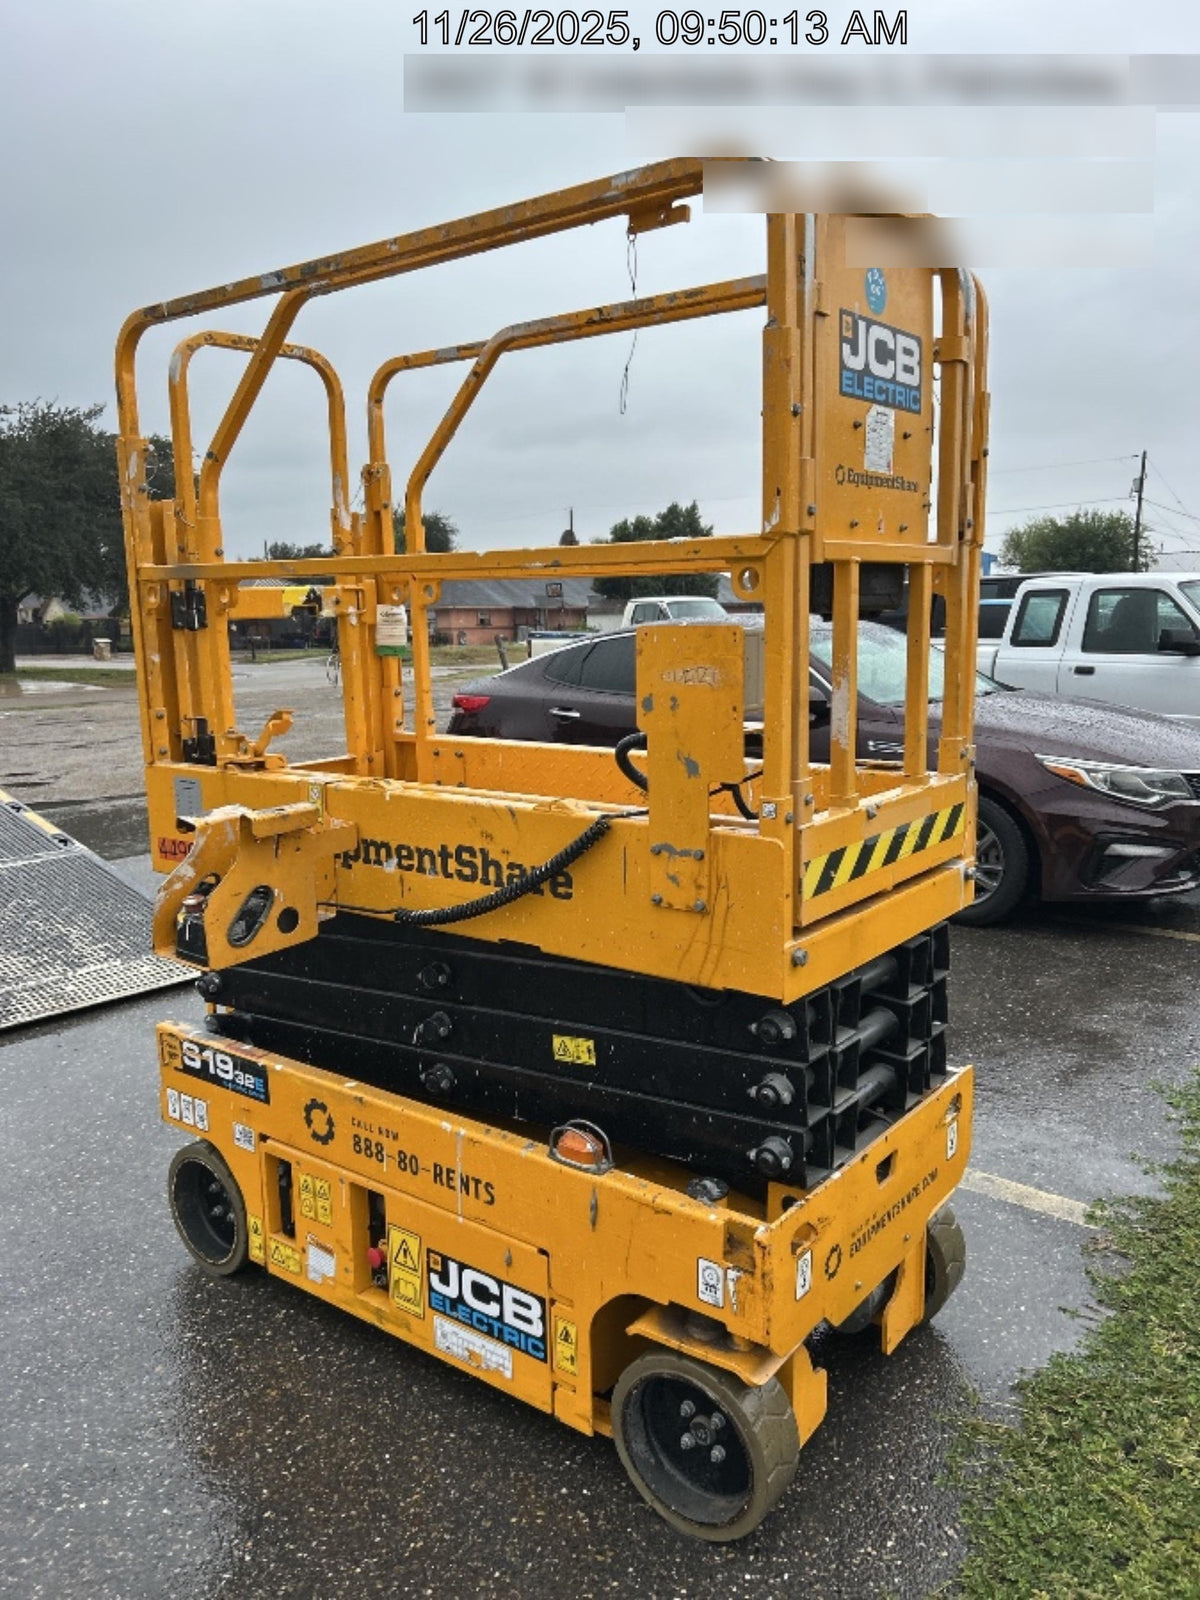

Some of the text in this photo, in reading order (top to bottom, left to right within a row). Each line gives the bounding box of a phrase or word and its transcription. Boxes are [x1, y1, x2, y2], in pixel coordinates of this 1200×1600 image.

[842, 319, 920, 387] JCB
[842, 369, 920, 412] ELECTRIC
[351, 1116, 399, 1141] CALL NOW
[353, 1134, 496, 1206] 888-80-RENTS
[430, 1260, 543, 1338] JCB
[430, 1291, 545, 1359] ELECTRIC
